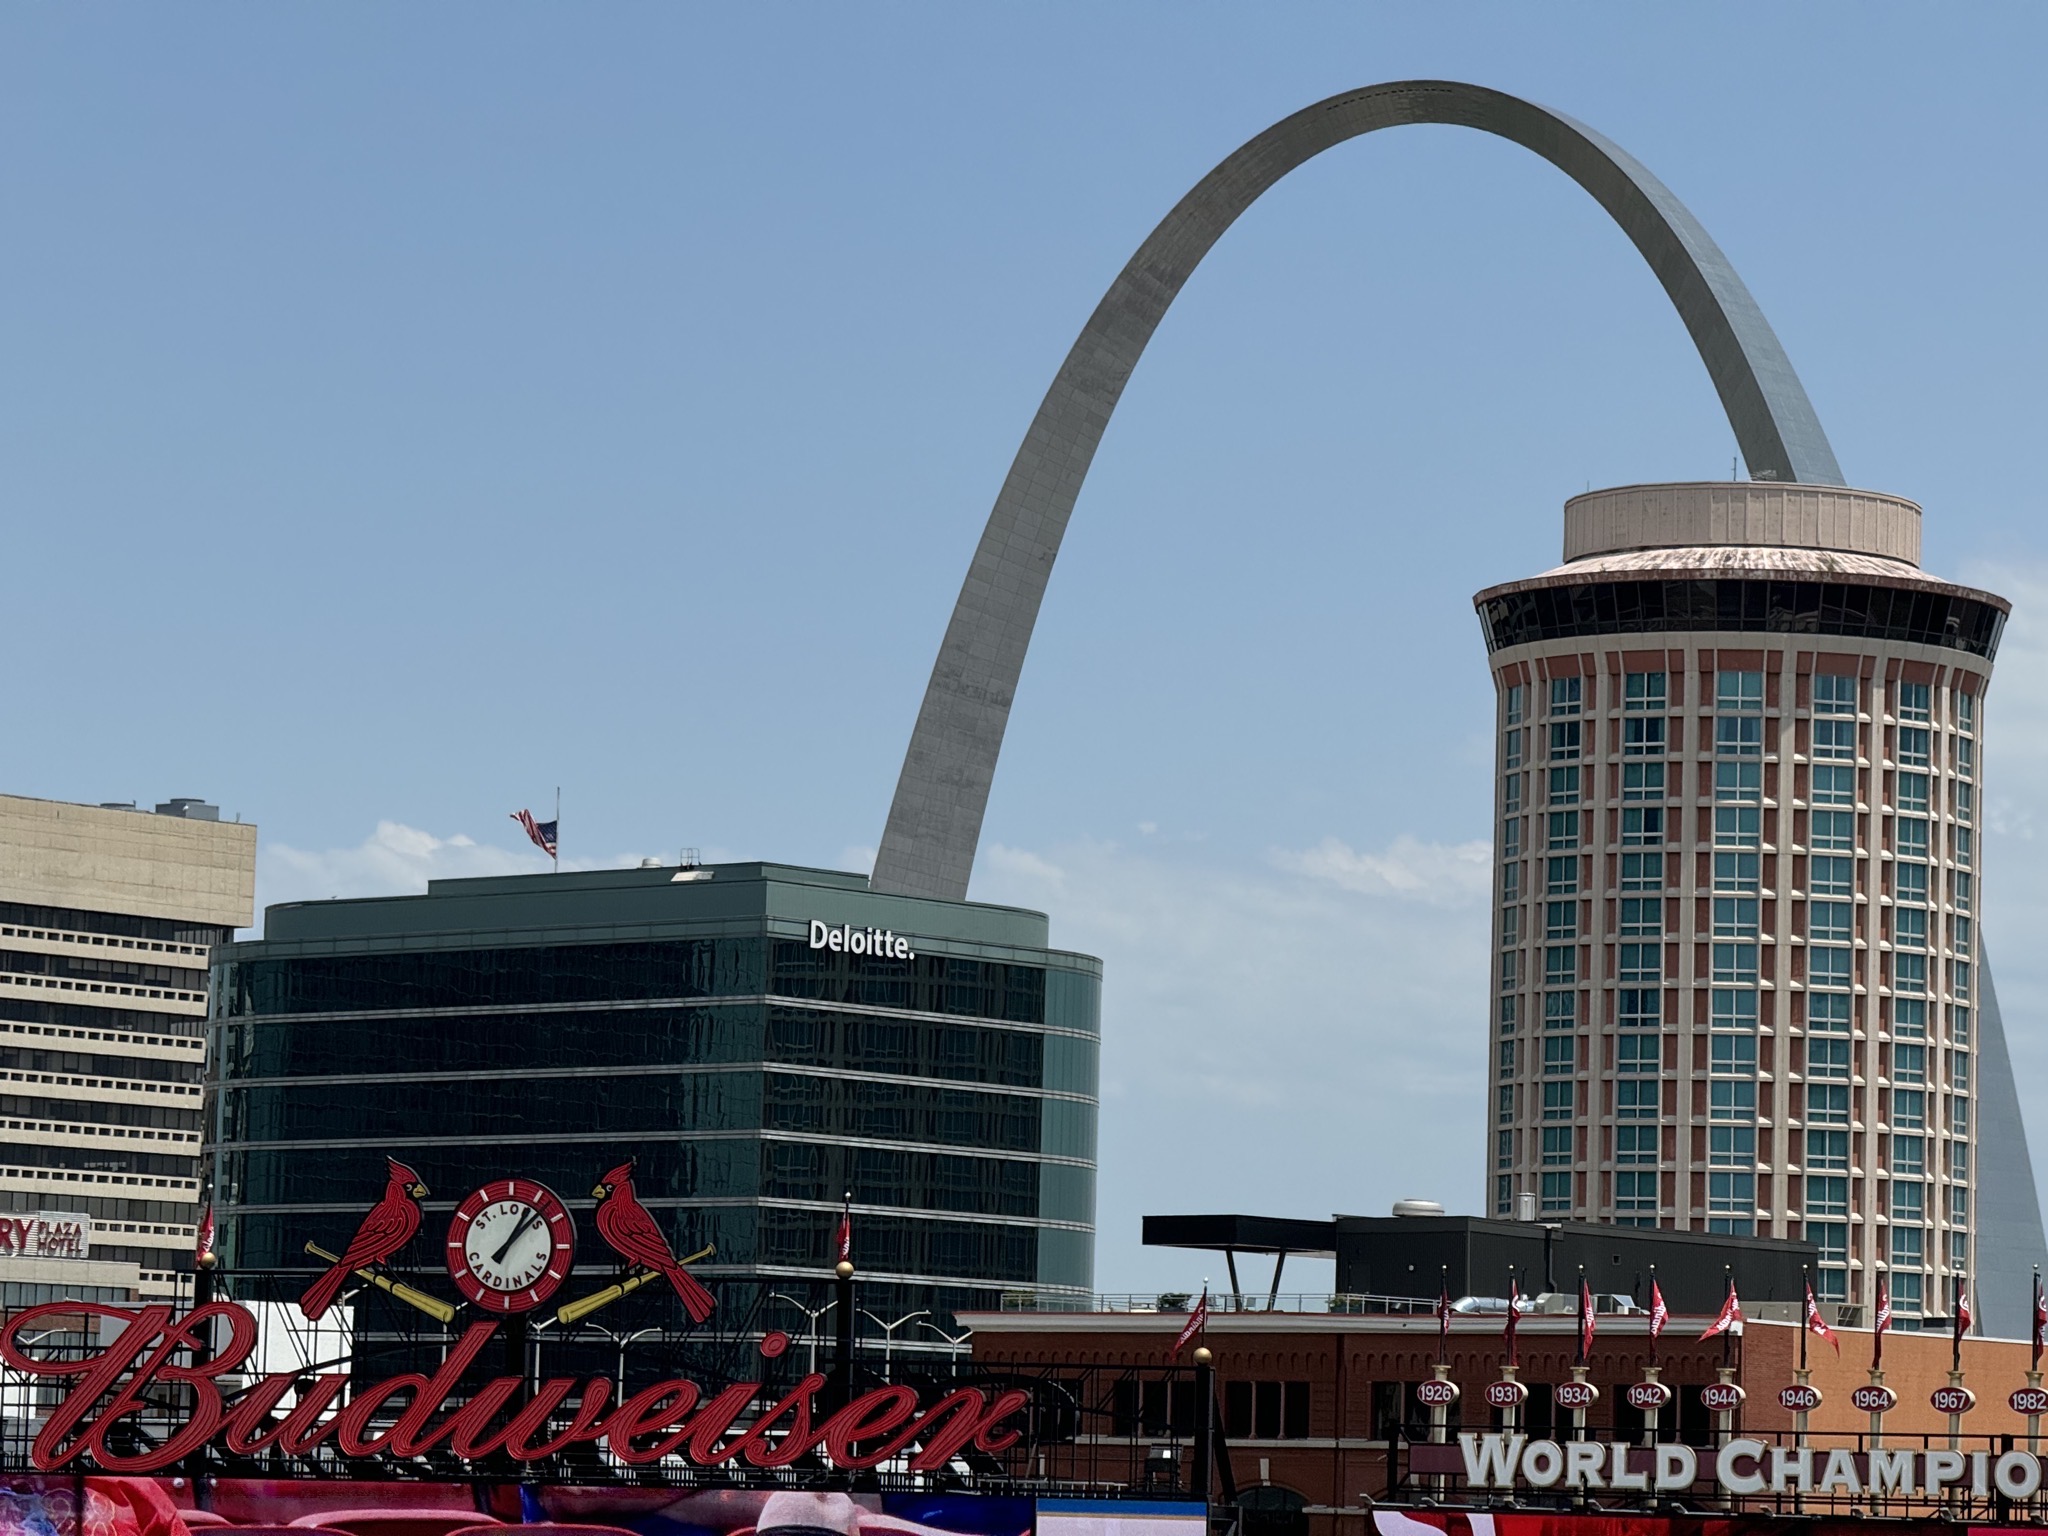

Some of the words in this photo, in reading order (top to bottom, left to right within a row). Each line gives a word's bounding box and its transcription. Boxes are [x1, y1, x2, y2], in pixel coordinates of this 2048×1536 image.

[810, 919, 915, 960] Deloitte.
[477, 1211, 496, 1229] ST.
[500, 1204, 543, 1230] LOS
[38, 1221, 82, 1236] PLAZA
[38, 1237, 83, 1253] HOTEL
[470, 1253, 546, 1288] CARDINALS
[0, 1301, 1031, 1473] Budweiser
[1420, 1385, 1451, 1401] 1926
[1490, 1386, 1518, 1402] 1931
[1558, 1387, 1590, 1403] 1934
[1630, 1388, 1662, 1404] 1942
[1705, 1389, 1738, 1405] 1944
[1781, 1390, 1814, 1406] 1946
[1855, 1390, 1889, 1407] 1964
[1934, 1392, 1966, 1408] 1967
[2012, 1393, 2047, 1409] 1982
[1458, 1433, 1697, 1491] WORLD
[1716, 1438, 2042, 1499] CHAMPIO
